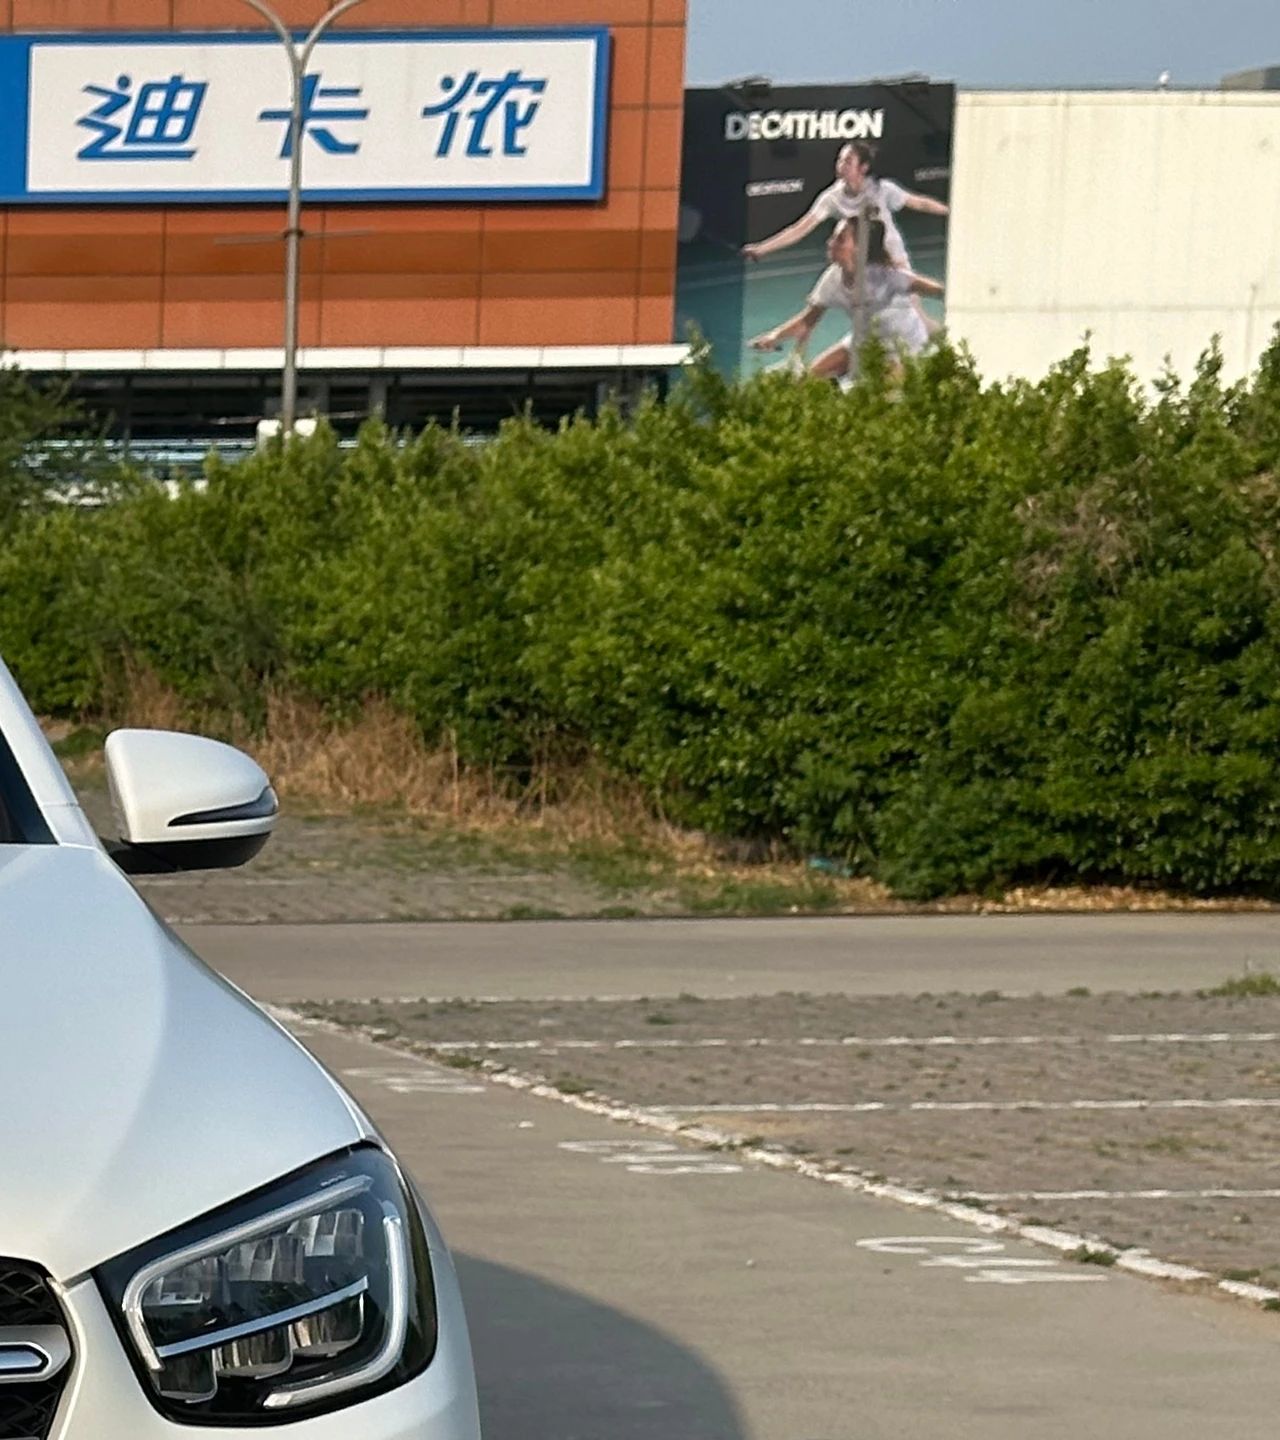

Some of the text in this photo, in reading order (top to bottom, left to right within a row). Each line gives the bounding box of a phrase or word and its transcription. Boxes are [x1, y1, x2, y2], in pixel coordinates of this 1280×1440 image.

[76, 69, 547, 160] 迪卡侬
[724, 108, 884, 141] DECATHLON
